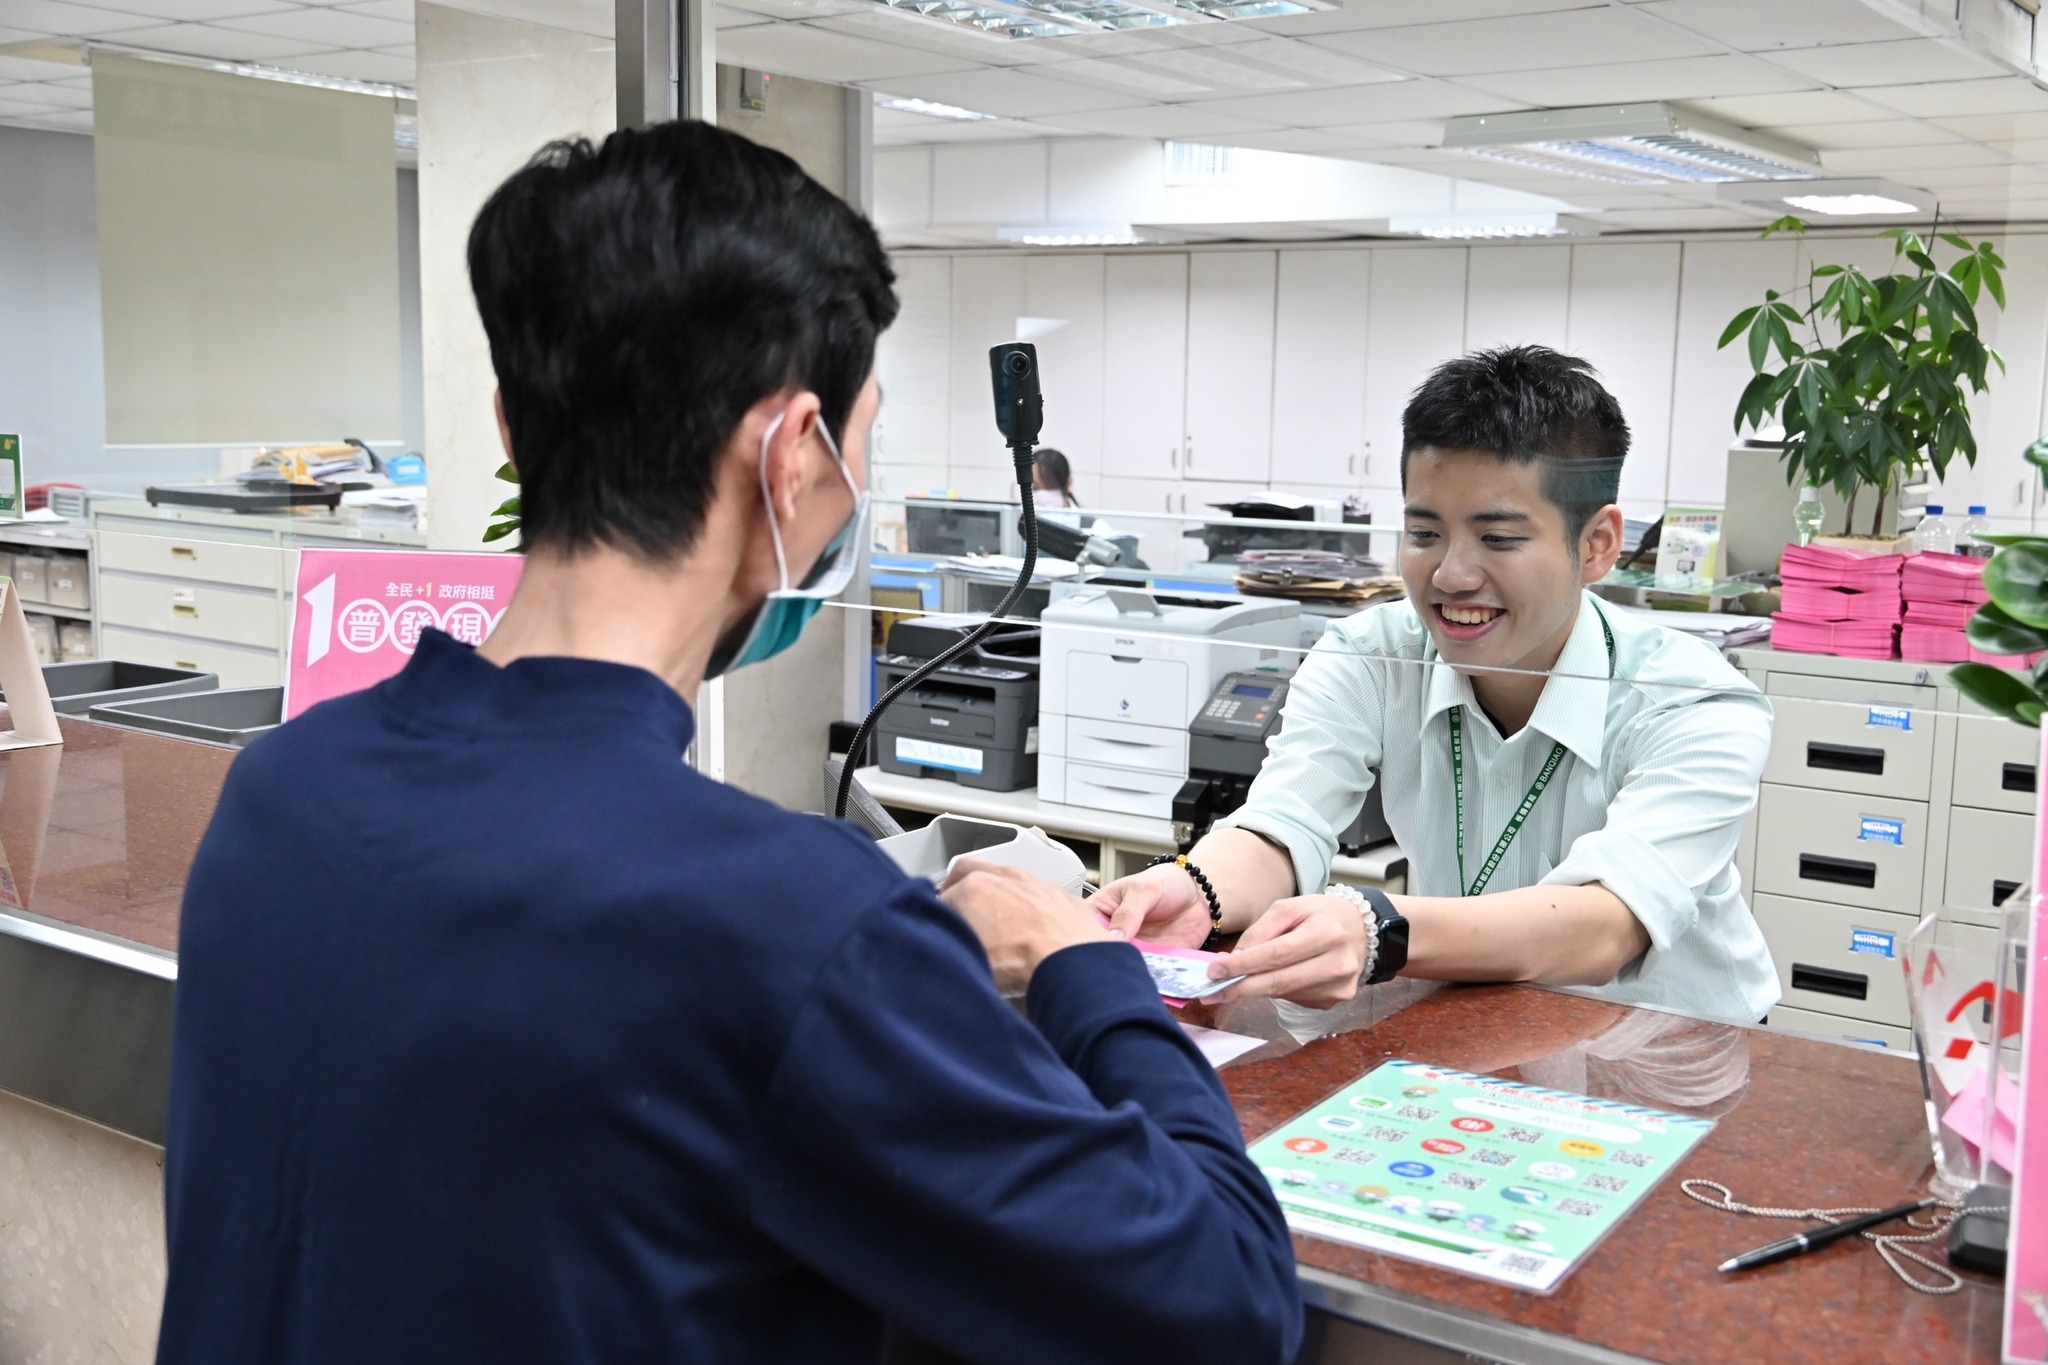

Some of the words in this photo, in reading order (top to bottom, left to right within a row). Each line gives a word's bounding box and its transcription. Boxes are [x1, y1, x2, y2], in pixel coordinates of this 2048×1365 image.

[438, 584, 495, 600] 政府相挺
[1115, 638, 1135, 646] EPSON
[1539, 747, 1563, 783] BANQIAO
[1515, 794, 1537, 823] 板橋郵局
[1472, 826, 1517, 895] 中華郵政股份有限公司
